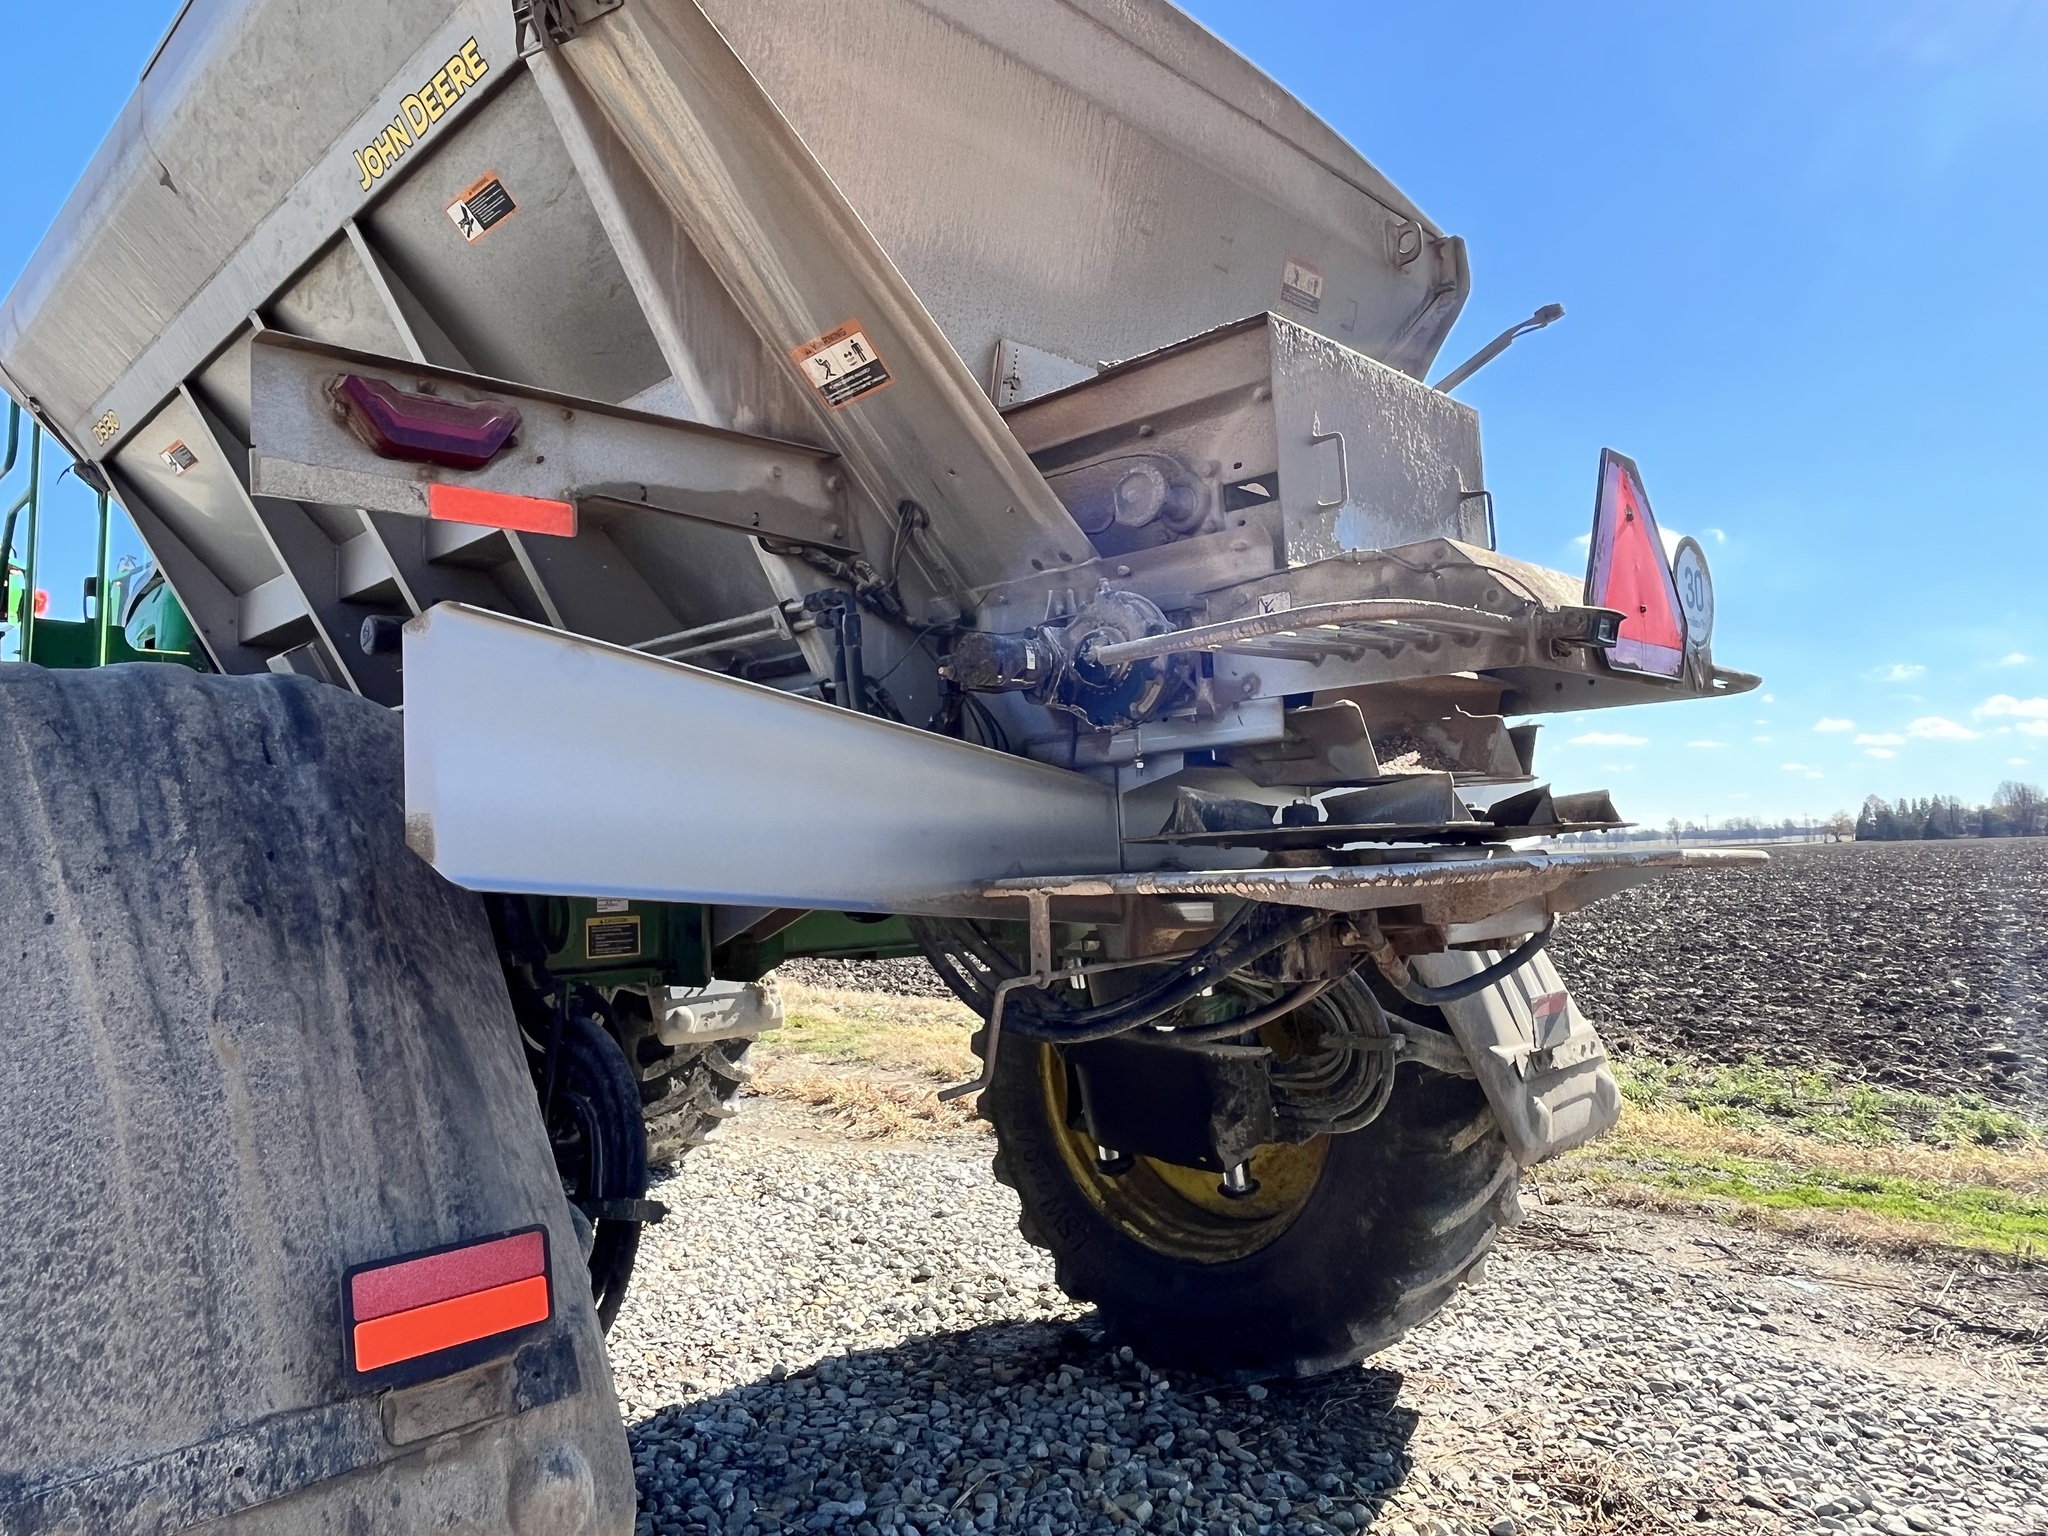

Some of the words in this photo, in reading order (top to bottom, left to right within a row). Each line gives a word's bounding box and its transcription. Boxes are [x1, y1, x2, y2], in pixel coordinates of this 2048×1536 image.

[353, 114, 414, 192] JOHN
[399, 36, 490, 140] DEERE
[811, 327, 847, 351] RNING
[1685, 566, 1704, 612] 30
